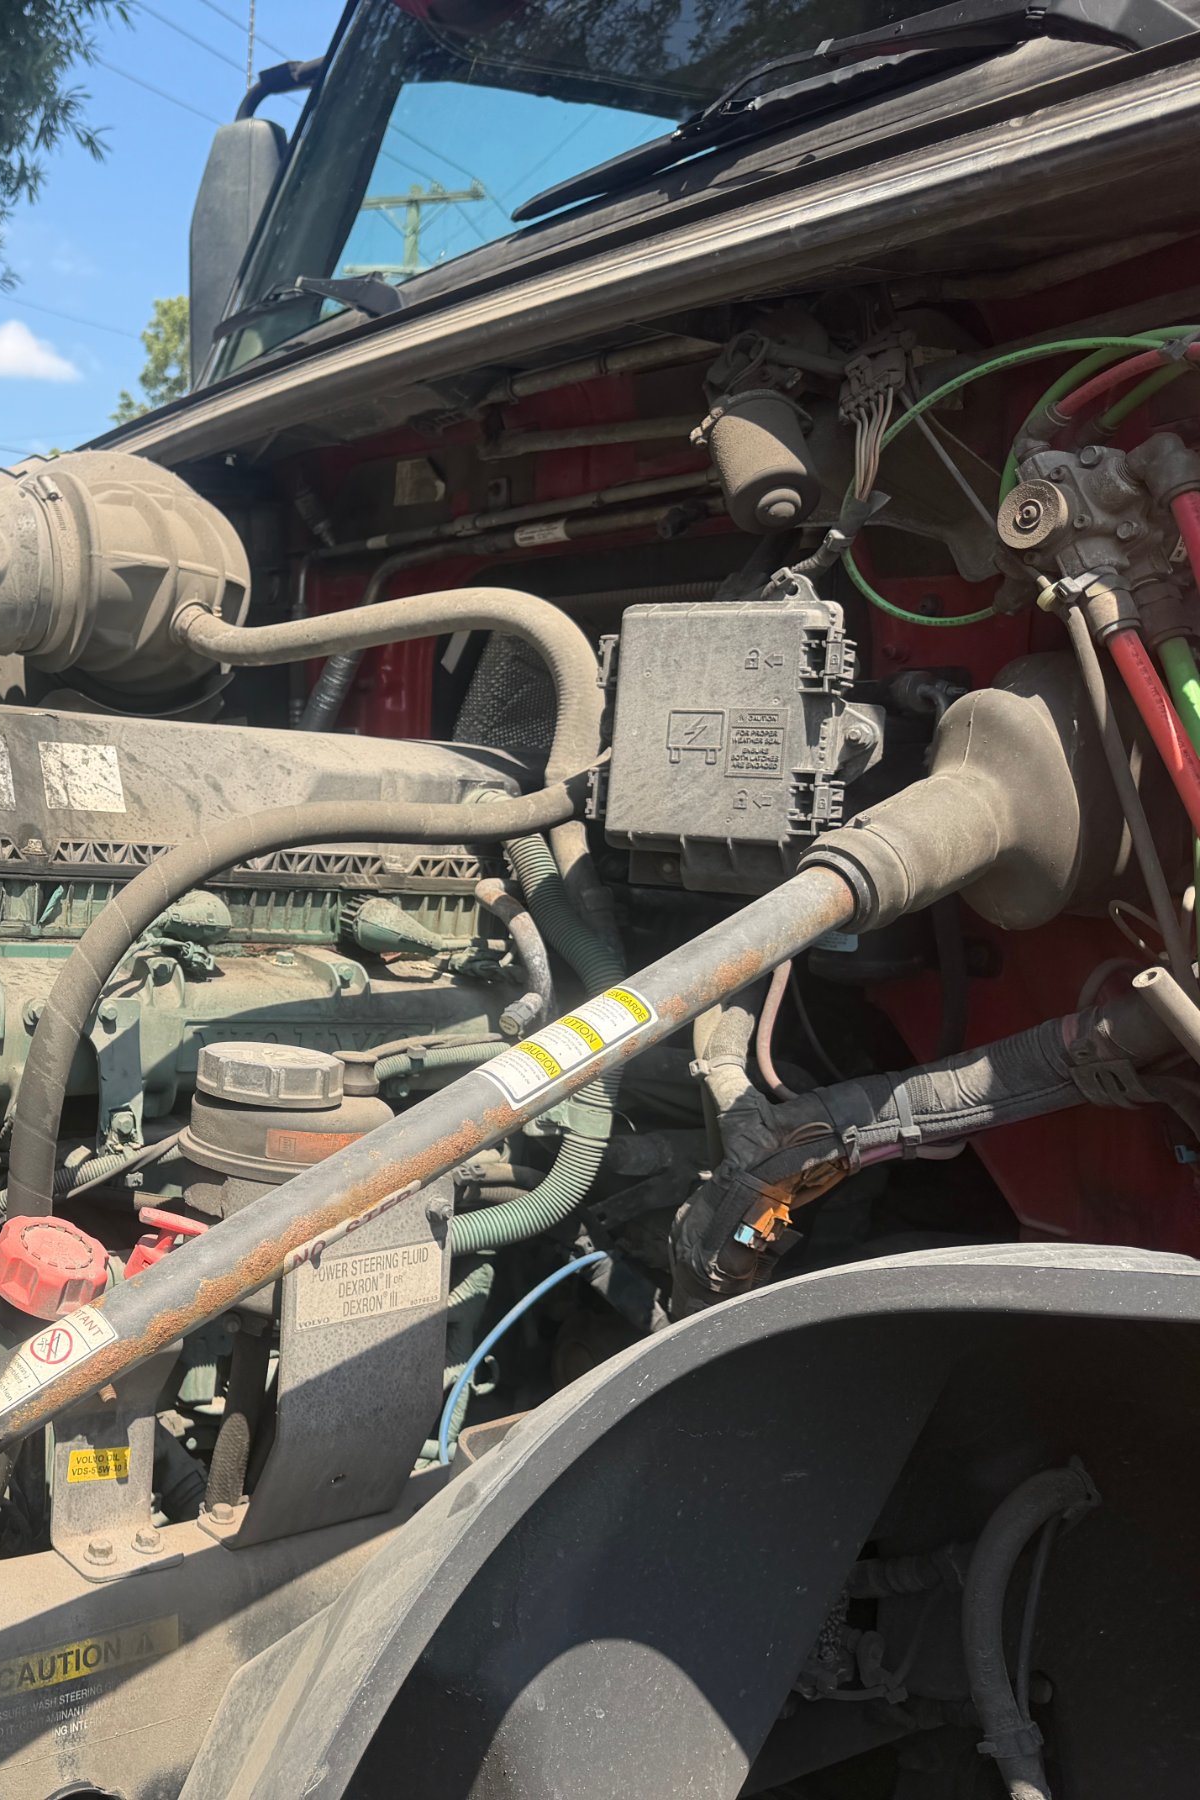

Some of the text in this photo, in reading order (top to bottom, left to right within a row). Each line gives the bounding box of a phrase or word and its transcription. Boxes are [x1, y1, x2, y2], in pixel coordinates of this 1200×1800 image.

[751, 730, 778, 738] PROPER
[619, 991, 647, 1020] GARDE
[312, 1247, 429, 1283] POWER STEERING FLUID
[298, 1317, 330, 1329] VOLVO
[76, 1453, 120, 1464] VOLVO OIL
[71, 1466, 96, 1476] VDS-5
[59, 1684, 103, 1706] STEERING
